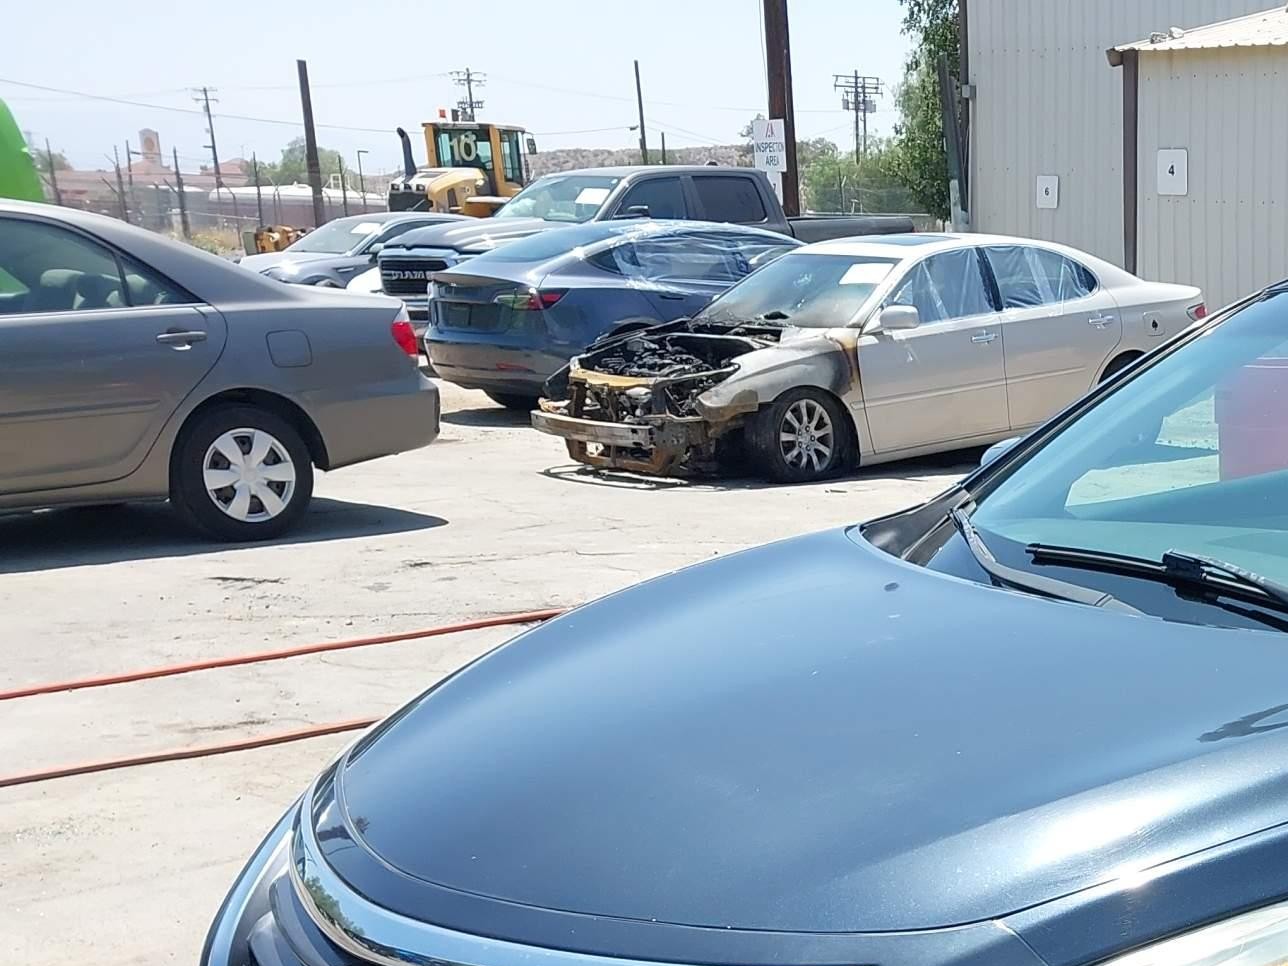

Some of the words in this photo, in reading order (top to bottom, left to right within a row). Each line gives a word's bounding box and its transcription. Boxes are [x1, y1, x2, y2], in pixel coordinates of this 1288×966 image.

[755, 142, 785, 153] INSPECTION
[766, 155, 780, 166] AREA
[1168, 164, 1175, 177] 4
[1044, 186, 1050, 196] 6
